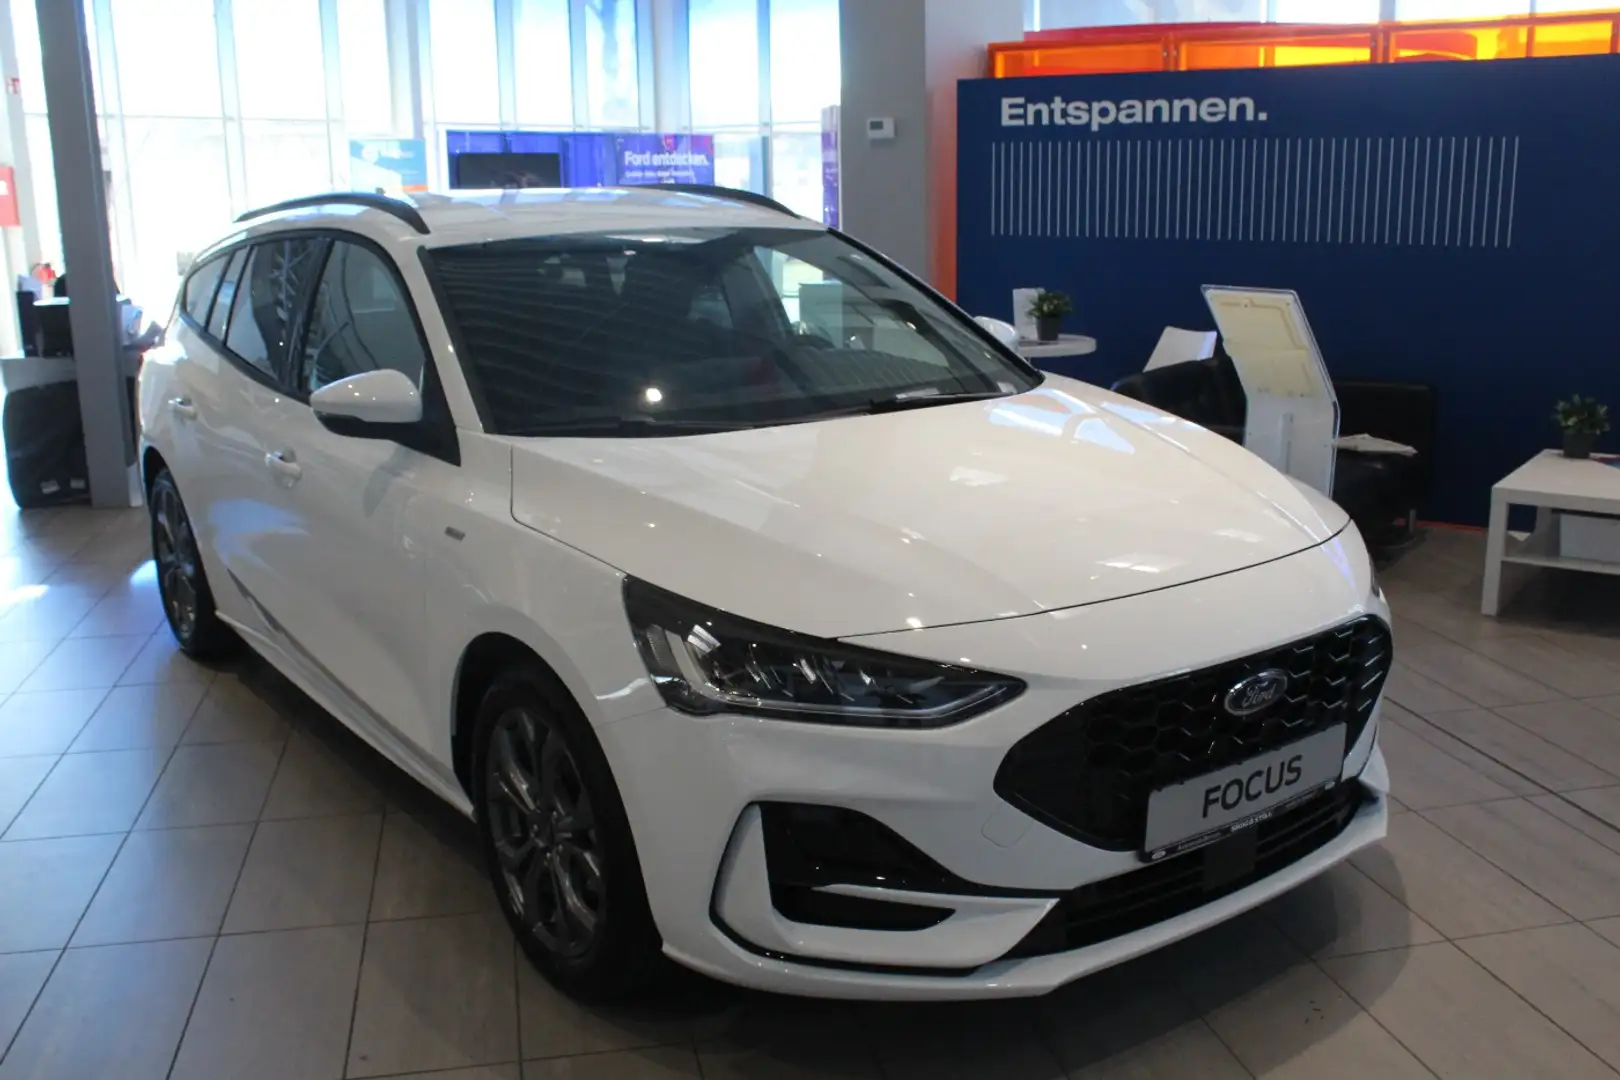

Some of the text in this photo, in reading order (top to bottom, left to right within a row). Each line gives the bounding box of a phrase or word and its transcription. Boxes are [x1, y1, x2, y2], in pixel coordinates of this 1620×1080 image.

[1001, 96, 1268, 131] Entspannen.
[624, 151, 651, 166] Ford
[1240, 681, 1277, 708] Ford
[1202, 755, 1303, 818] FOCUS
